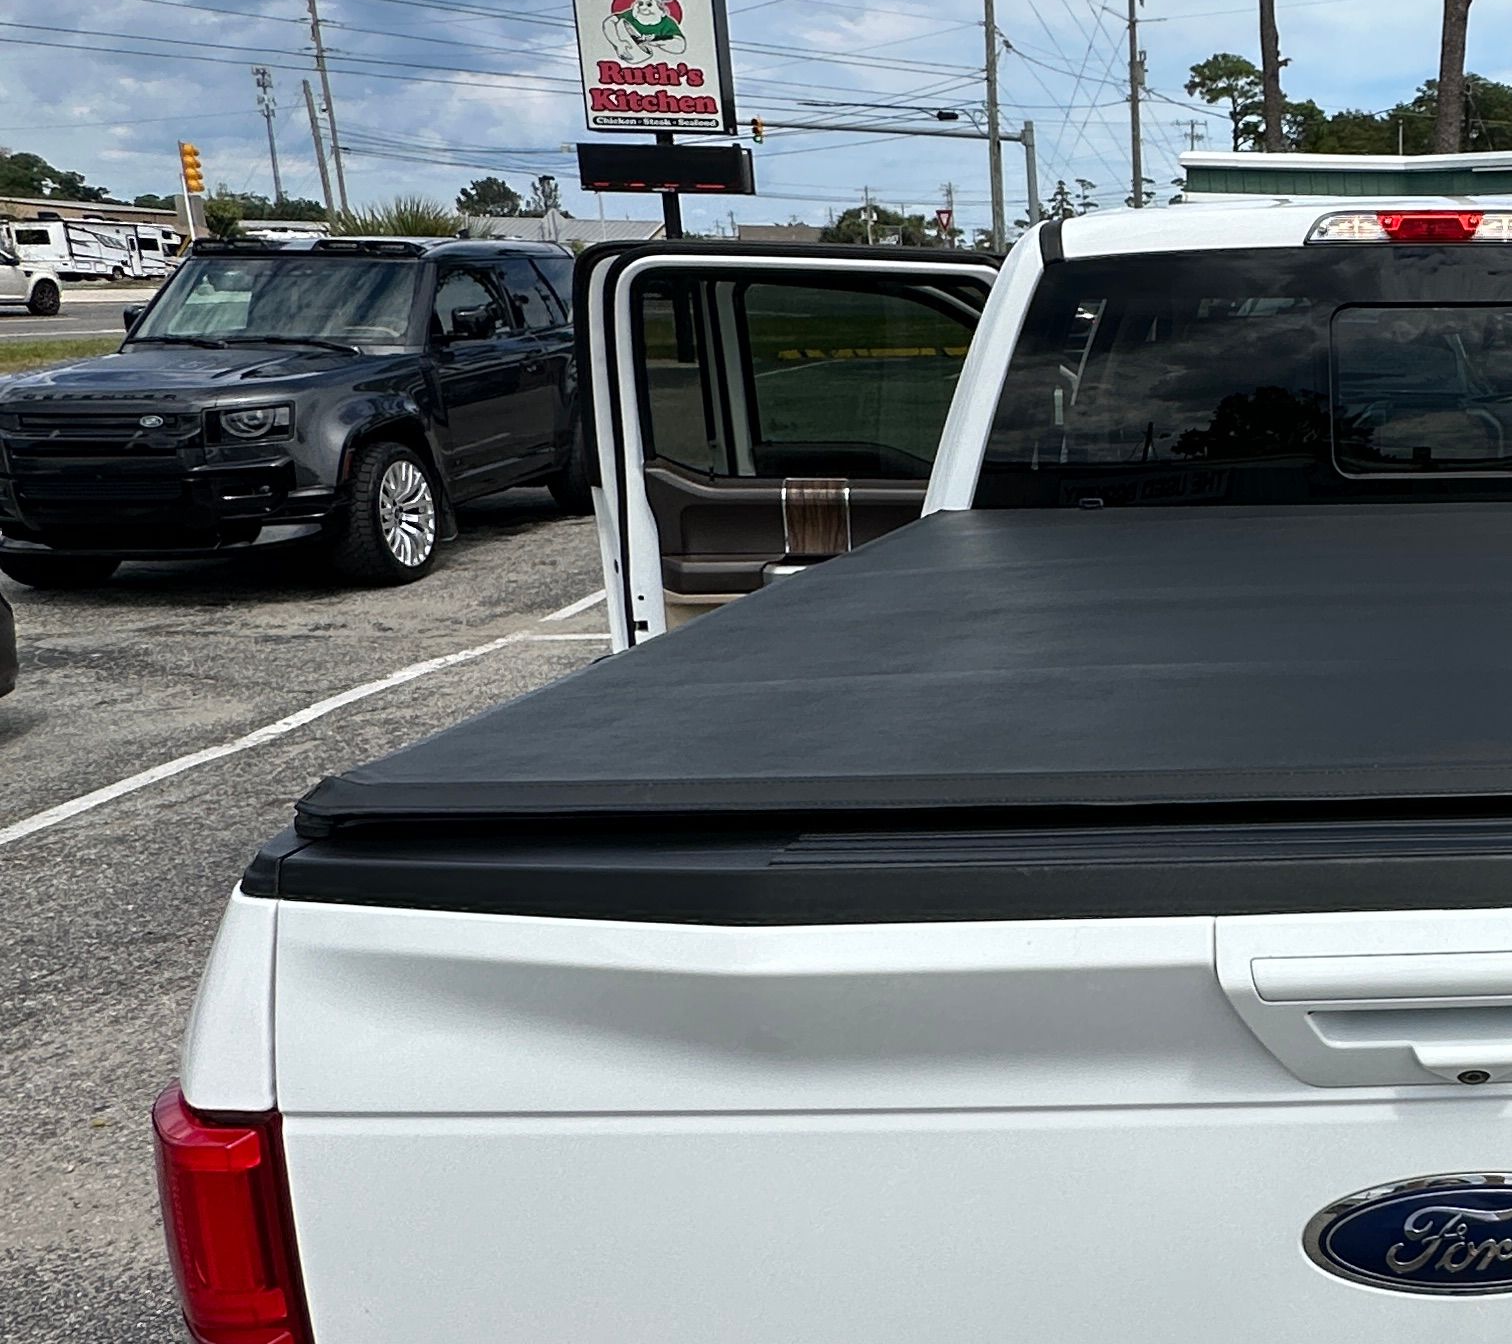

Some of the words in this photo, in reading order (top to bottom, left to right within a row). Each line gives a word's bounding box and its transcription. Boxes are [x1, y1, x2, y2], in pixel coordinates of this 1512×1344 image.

[597, 61, 705, 87] Ruth's
[589, 88, 718, 114] Kitchen
[596, 117, 637, 125] Chicken
[643, 118, 672, 126] Steak
[678, 119, 717, 127] Seafood
